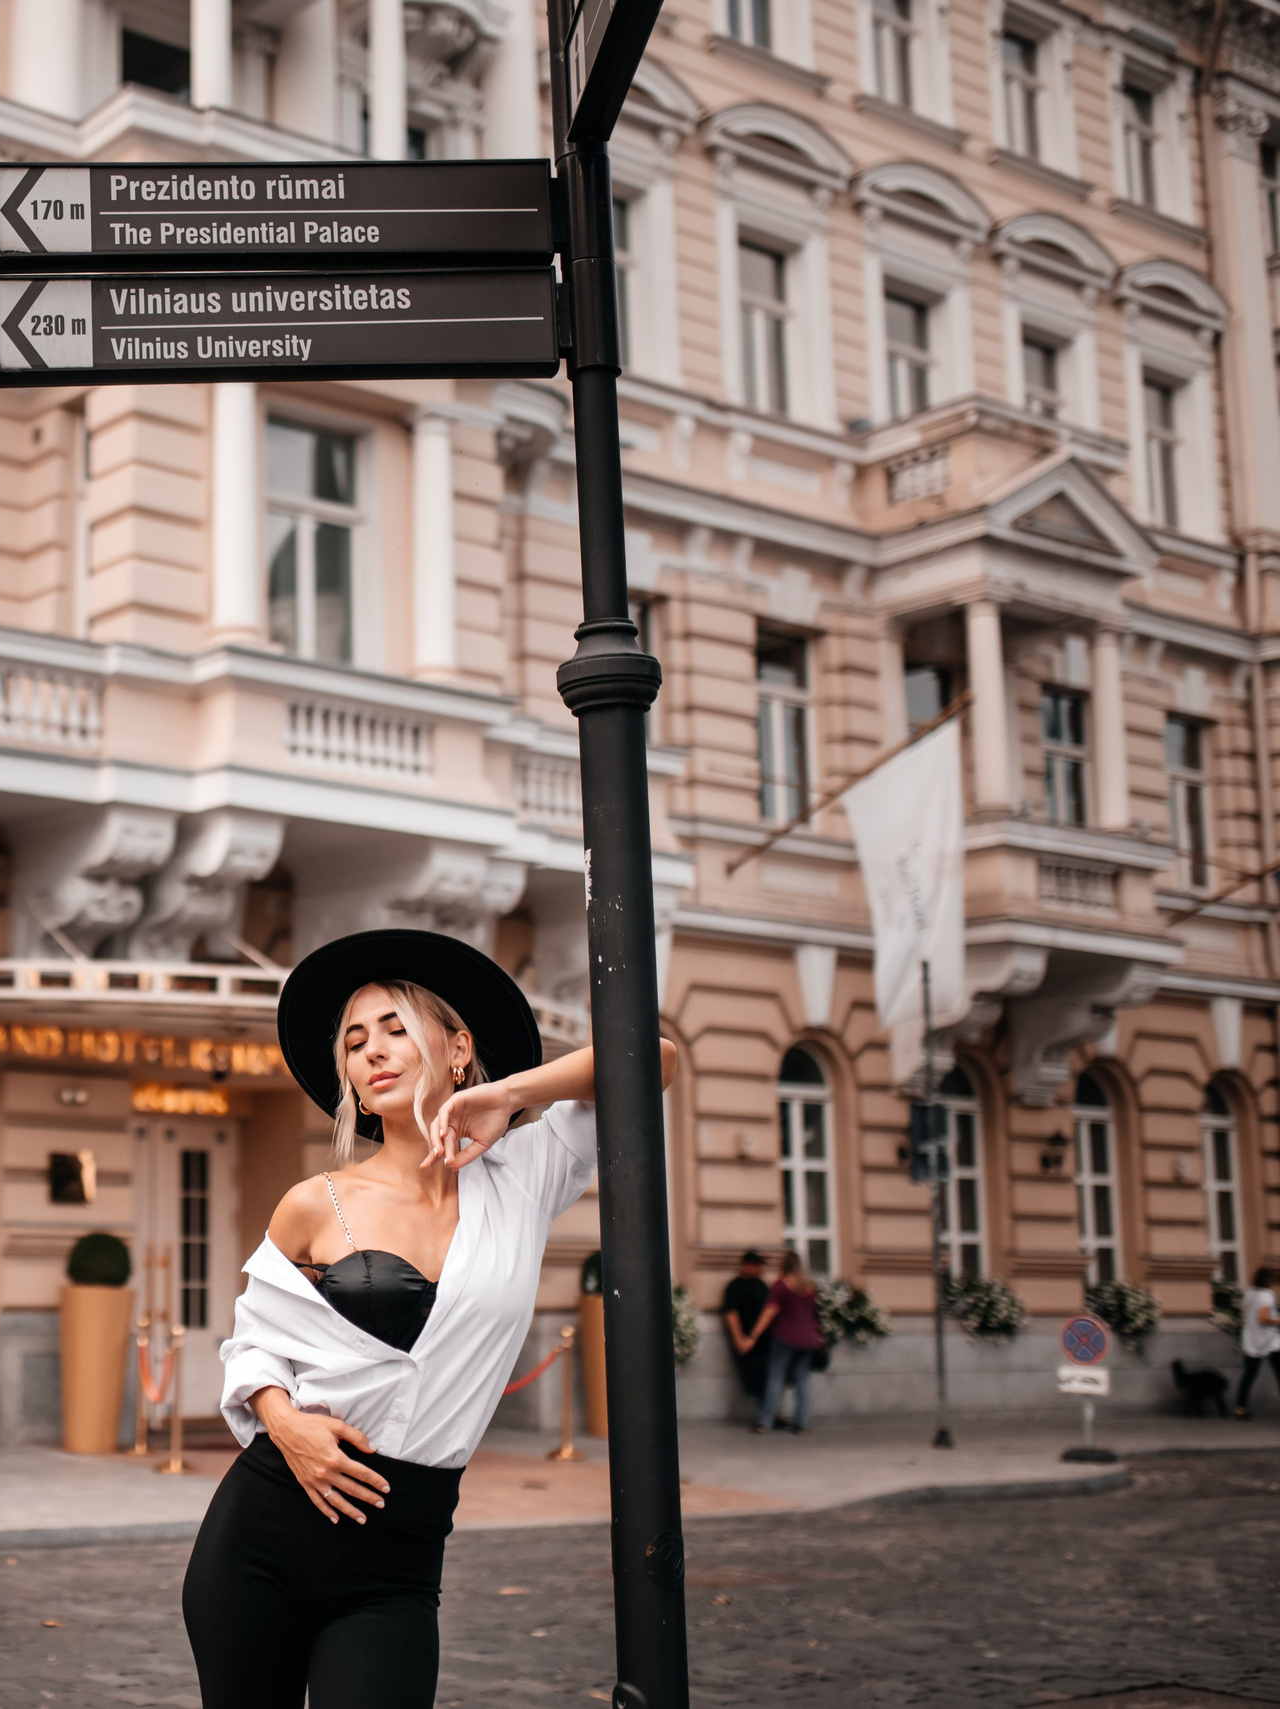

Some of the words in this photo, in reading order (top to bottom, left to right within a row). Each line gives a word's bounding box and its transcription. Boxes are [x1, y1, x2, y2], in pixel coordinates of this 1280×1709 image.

[110, 175, 256, 201] Prezidento
[266, 174, 345, 200] rūmai
[30, 199, 64, 221] 170
[70, 204, 85, 220] m
[110, 223, 151, 245] The
[160, 222, 296, 245] Presidential
[303, 221, 380, 244] Palace
[110, 288, 222, 315] Vilniaus
[231, 284, 411, 313] universitetas
[30, 315, 65, 336] 230
[71, 319, 87, 336] m
[110, 337, 189, 360] Vilnius
[196, 335, 312, 362] University
